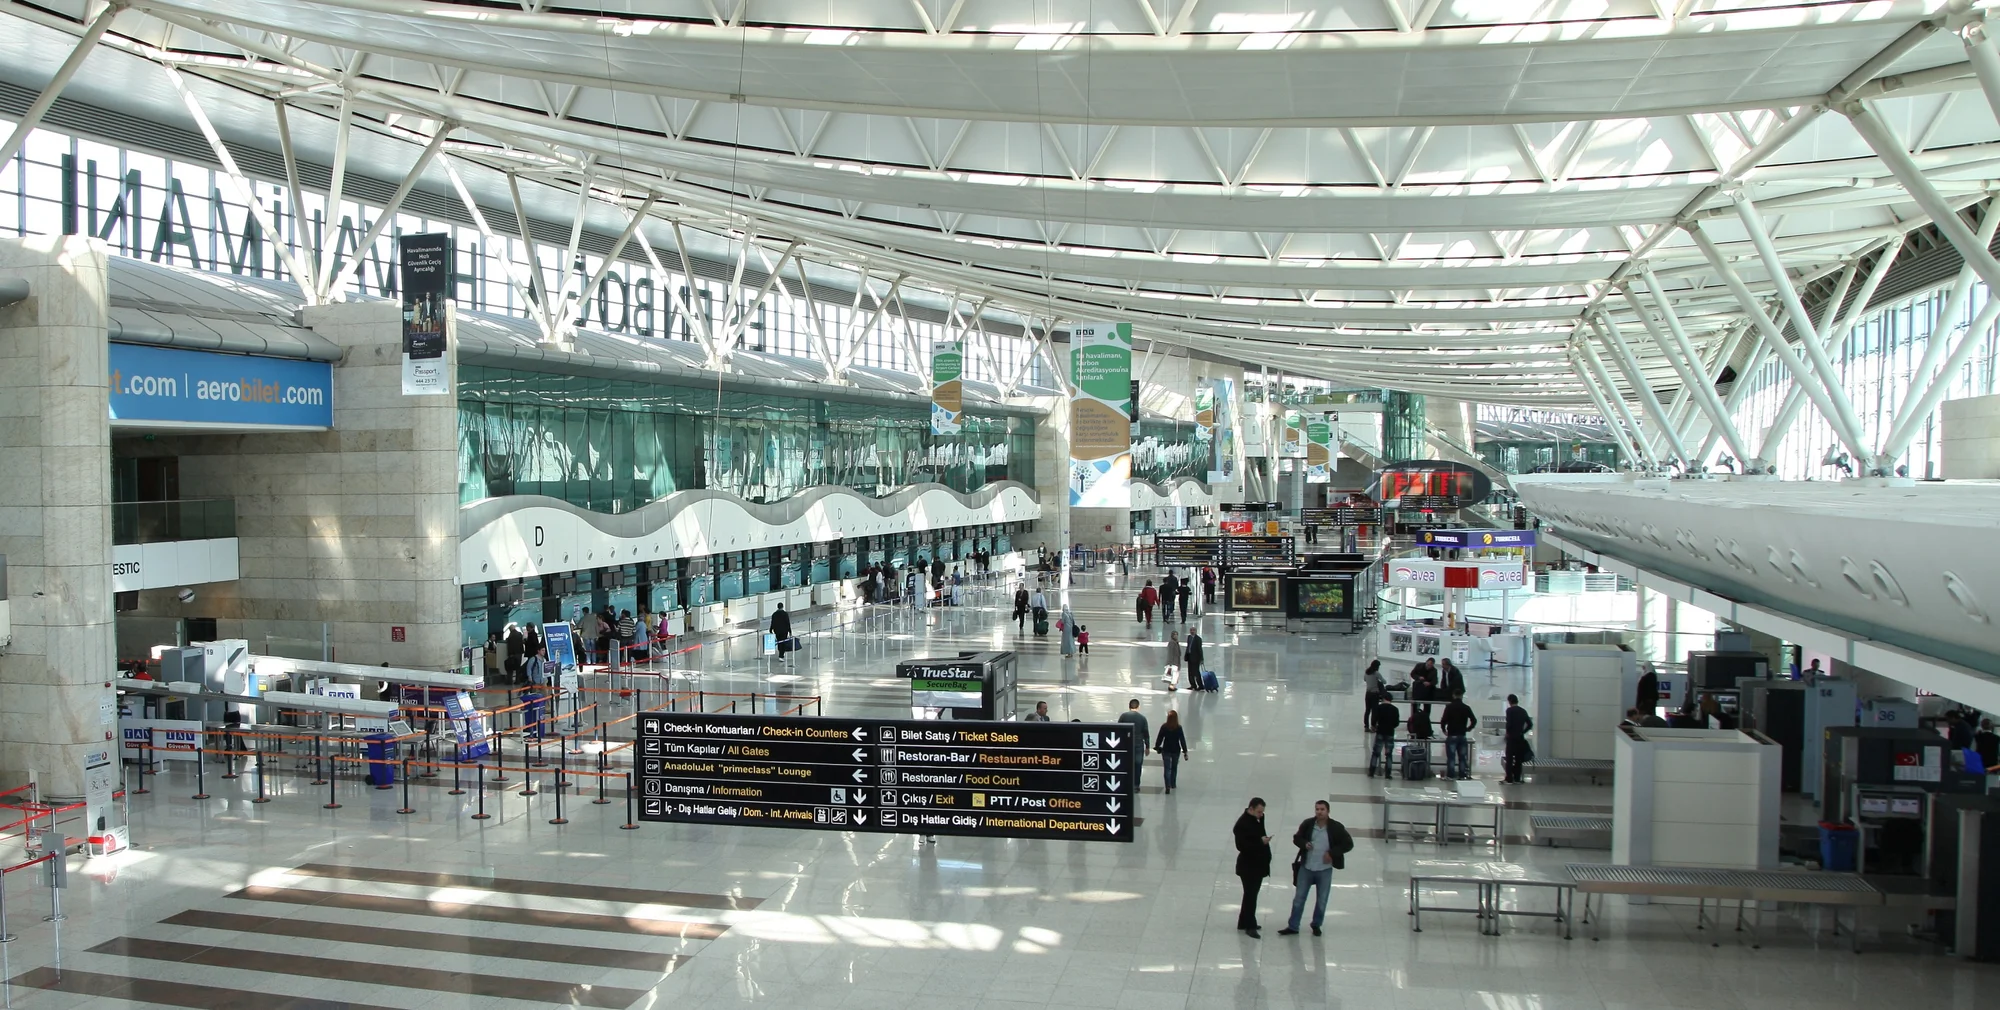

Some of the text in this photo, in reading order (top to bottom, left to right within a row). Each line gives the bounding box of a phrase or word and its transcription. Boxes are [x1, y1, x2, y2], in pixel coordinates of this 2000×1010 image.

[197, 378, 323, 405] aerobilet.com
[1012, 495, 1017, 507] D
[837, 508, 842, 520] D
[535, 525, 544, 547] D
[113, 562, 140, 575] ESTIC
[1412, 570, 1435, 582] avea
[1498, 571, 1521, 582] avea
[921, 667, 972, 678] TrueStar
[926, 681, 967, 690] SecureBag
[1879, 710, 1895, 722] 36
[664, 723, 703, 733] Check-in
[705, 724, 754, 735] Kontuarları
[762, 726, 804, 737] Check-in
[806, 728, 848, 738] Counters
[901, 731, 923, 741] Bilet
[925, 731, 950, 742] Satış
[958, 732, 987, 742] Ticket
[990, 733, 1019, 742] Sales
[664, 743, 685, 752] Tüm
[687, 744, 719, 755] Kapılar
[728, 746, 740, 755] All
[741, 746, 769, 756] Gates
[898, 751, 970, 763] Restoran-Bar
[979, 754, 1061, 765] Restaurant-Bar
[664, 763, 811, 777] AnadoluJet "primeclass" Lounge
[902, 773, 957, 784] Restoranlar
[965, 775, 990, 785] Food
[992, 775, 1020, 786] Court
[665, 784, 704, 795] Danışma
[712, 785, 762, 797] Information
[902, 793, 927, 806] Çıkış
[936, 794, 954, 805] Exit
[990, 796, 1012, 806] PTT
[1022, 797, 1046, 807] Post
[1049, 798, 1081, 809] Office
[665, 801, 673, 814] İç
[678, 804, 692, 816] Dış
[693, 804, 716, 815] Hatlar
[717, 806, 737, 817] Geliş
[743, 807, 764, 817] Dom.
[770, 808, 782, 818] Int.
[784, 810, 813, 820] Arrivals
[902, 814, 918, 826] Dış
[921, 814, 949, 825] Hatlar
[952, 815, 977, 828] Gidiş
[985, 817, 1046, 829] International
[1049, 819, 1104, 832] Departures
